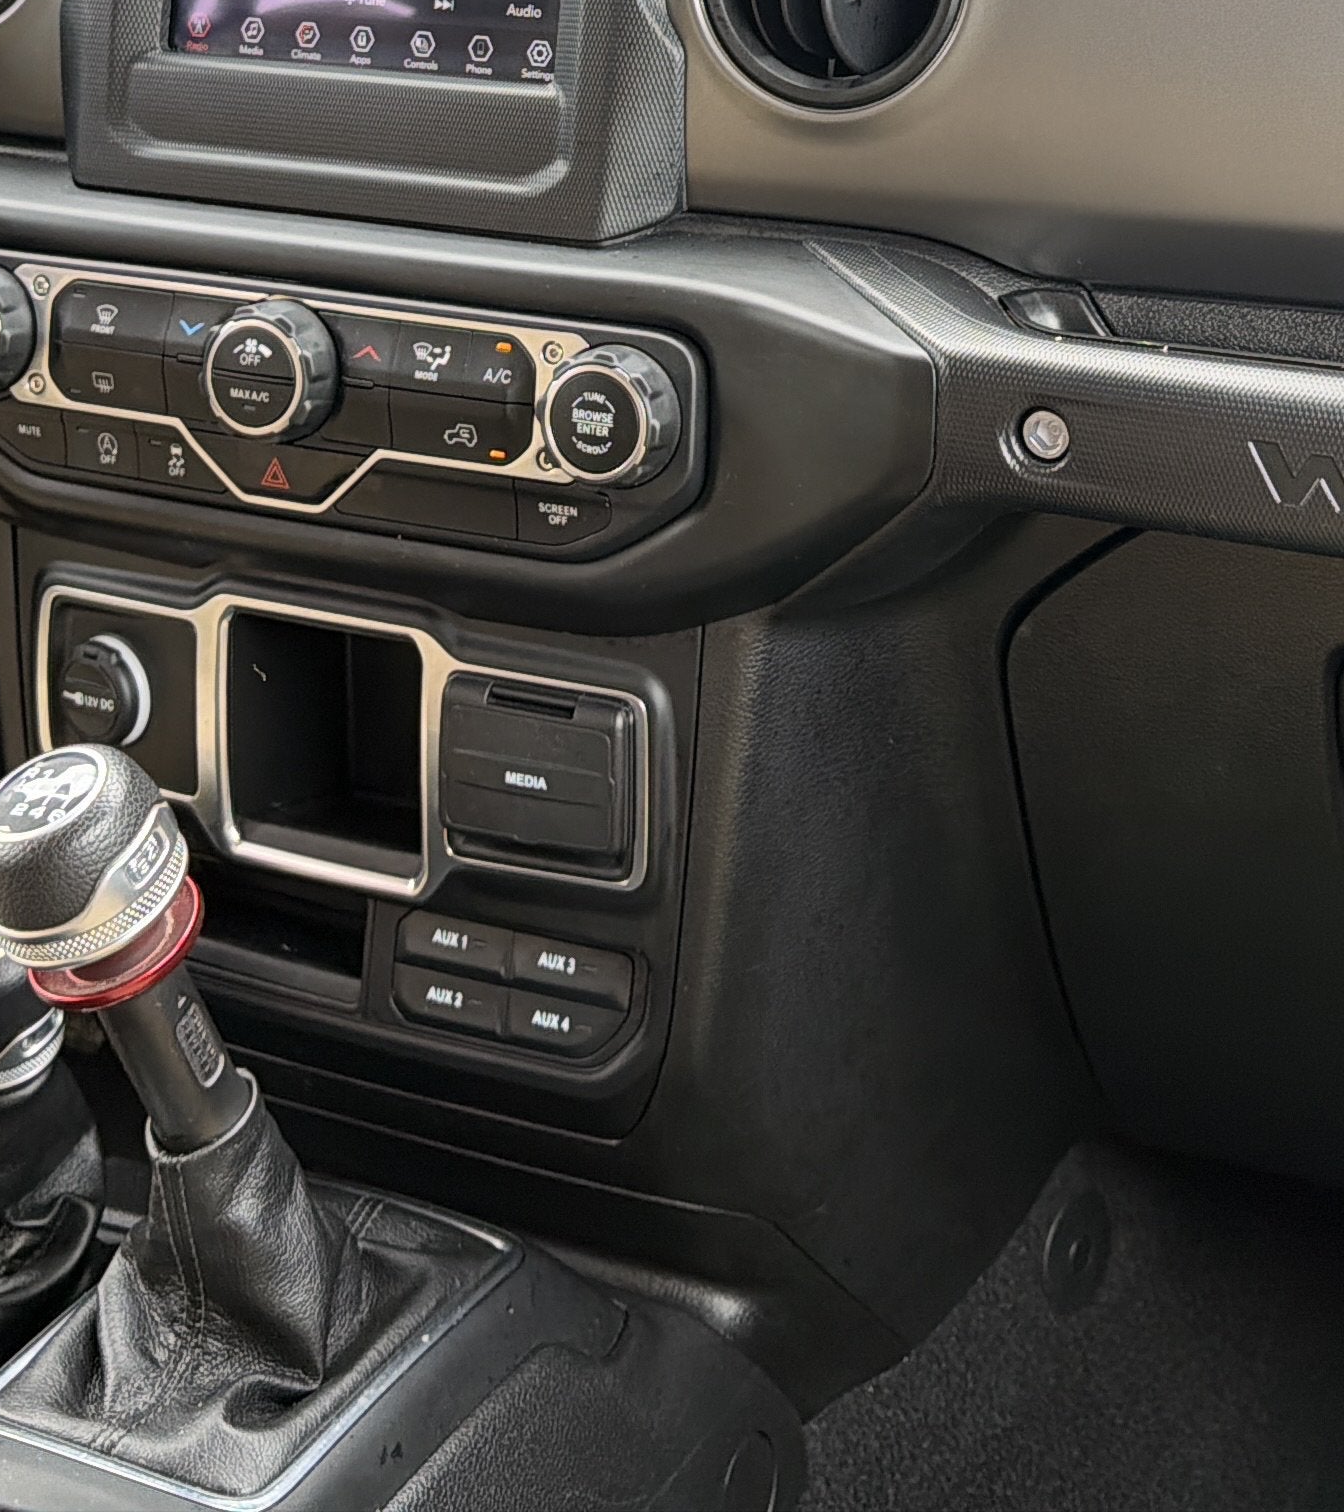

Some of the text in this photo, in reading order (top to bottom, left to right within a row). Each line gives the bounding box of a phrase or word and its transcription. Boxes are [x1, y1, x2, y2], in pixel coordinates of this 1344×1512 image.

[506, 2, 543, 19] Audio
[239, 44, 264, 57] Media
[291, 48, 322, 62] Climate
[349, 53, 372, 66] Apps
[404, 58, 439, 72] Controls
[465, 63, 494, 76] Phone
[239, 352, 262, 368] OFF
[414, 369, 438, 382] MODE
[483, 367, 512, 385] A/C
[230, 387, 270, 404] MAX A/C
[583, 391, 606, 405] TUNE
[571, 406, 614, 424] BROWSE
[17, 423, 42, 438] MUTE
[576, 422, 610, 438] ENTER
[576, 440, 609, 456] SCROLL
[99, 454, 117, 466] OFF
[168, 466, 186, 478] OFF
[538, 501, 578, 518] SCREEN
[548, 513, 569, 526] OFF
[100, 697, 115, 712] DC
[505, 770, 548, 791] MEDIA
[28, 805, 47, 820] 4
[431, 928, 468, 951] AUX 1
[537, 951, 577, 976] AUX 3
[426, 985, 464, 1009] AUX 2
[532, 1009, 571, 1033] AUX 4
